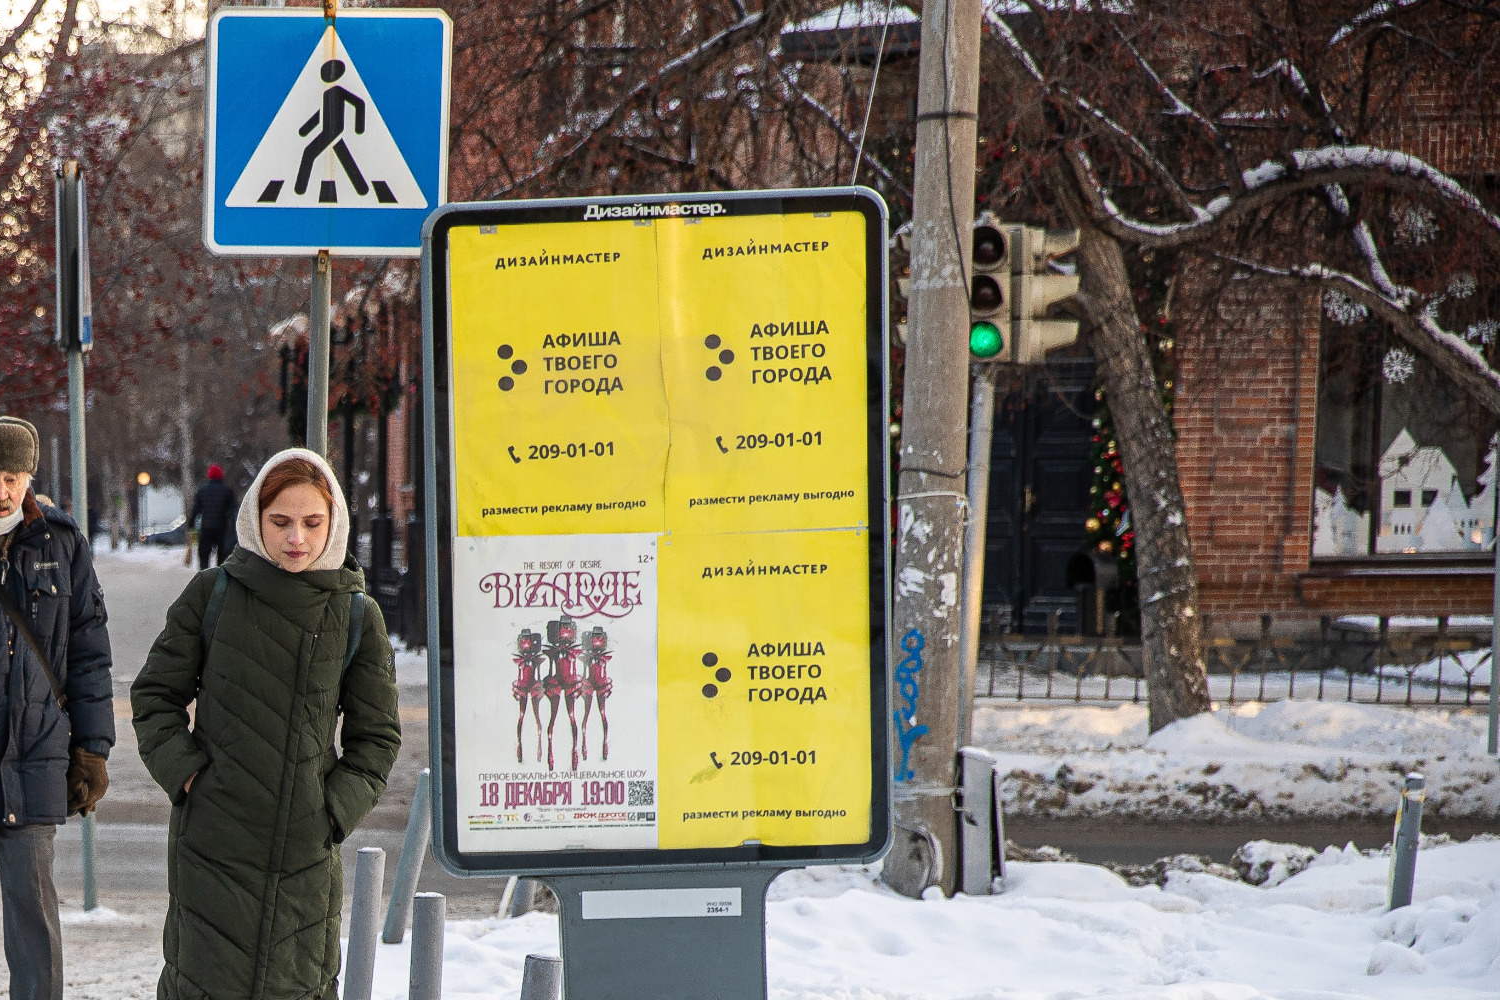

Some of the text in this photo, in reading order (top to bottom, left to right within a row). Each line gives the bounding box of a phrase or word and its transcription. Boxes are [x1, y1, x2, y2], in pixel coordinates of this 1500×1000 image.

[583, 203, 727, 221] Дизайнмастер.
[701, 238, 830, 261] ДИЗАЙНМАСТЕР
[494, 248, 621, 271] ДИЗАЙНМАСТЕР
[749, 319, 830, 339] АФИША
[542, 330, 622, 349] АФИША
[749, 342, 826, 362] ТВОЕГО
[542, 353, 618, 372] ТВОЕГО
[751, 365, 833, 386] ГОРОДА
[544, 376, 624, 397] ГОРОДА
[735, 430, 822, 450] 209-01-01
[528, 441, 614, 460] 209-01-01
[481, 499, 647, 519] размести рекламу выгодно
[689, 490, 855, 509] размести рекламу выгодно
[523, 559, 602, 571] THE RESORT OF DESIRE
[637, 554, 655, 564] 12+
[701, 558, 828, 579] ДИЗАЙНМАСТЕР
[746, 641, 826, 658] АФИША
[746, 664, 822, 681] ТВОЕГО
[748, 686, 828, 705] ГОРОДА
[730, 749, 816, 766] 209-01-01
[478, 769, 647, 782] ПЕРВОЕ ВОКАЛЬНО-ТАНЦЕВАЛЬНОЕ ШОУ
[479, 780, 625, 810] 18 ДЕКАБРЯ 19:00
[682, 809, 847, 823] размести рекламу выгодно
